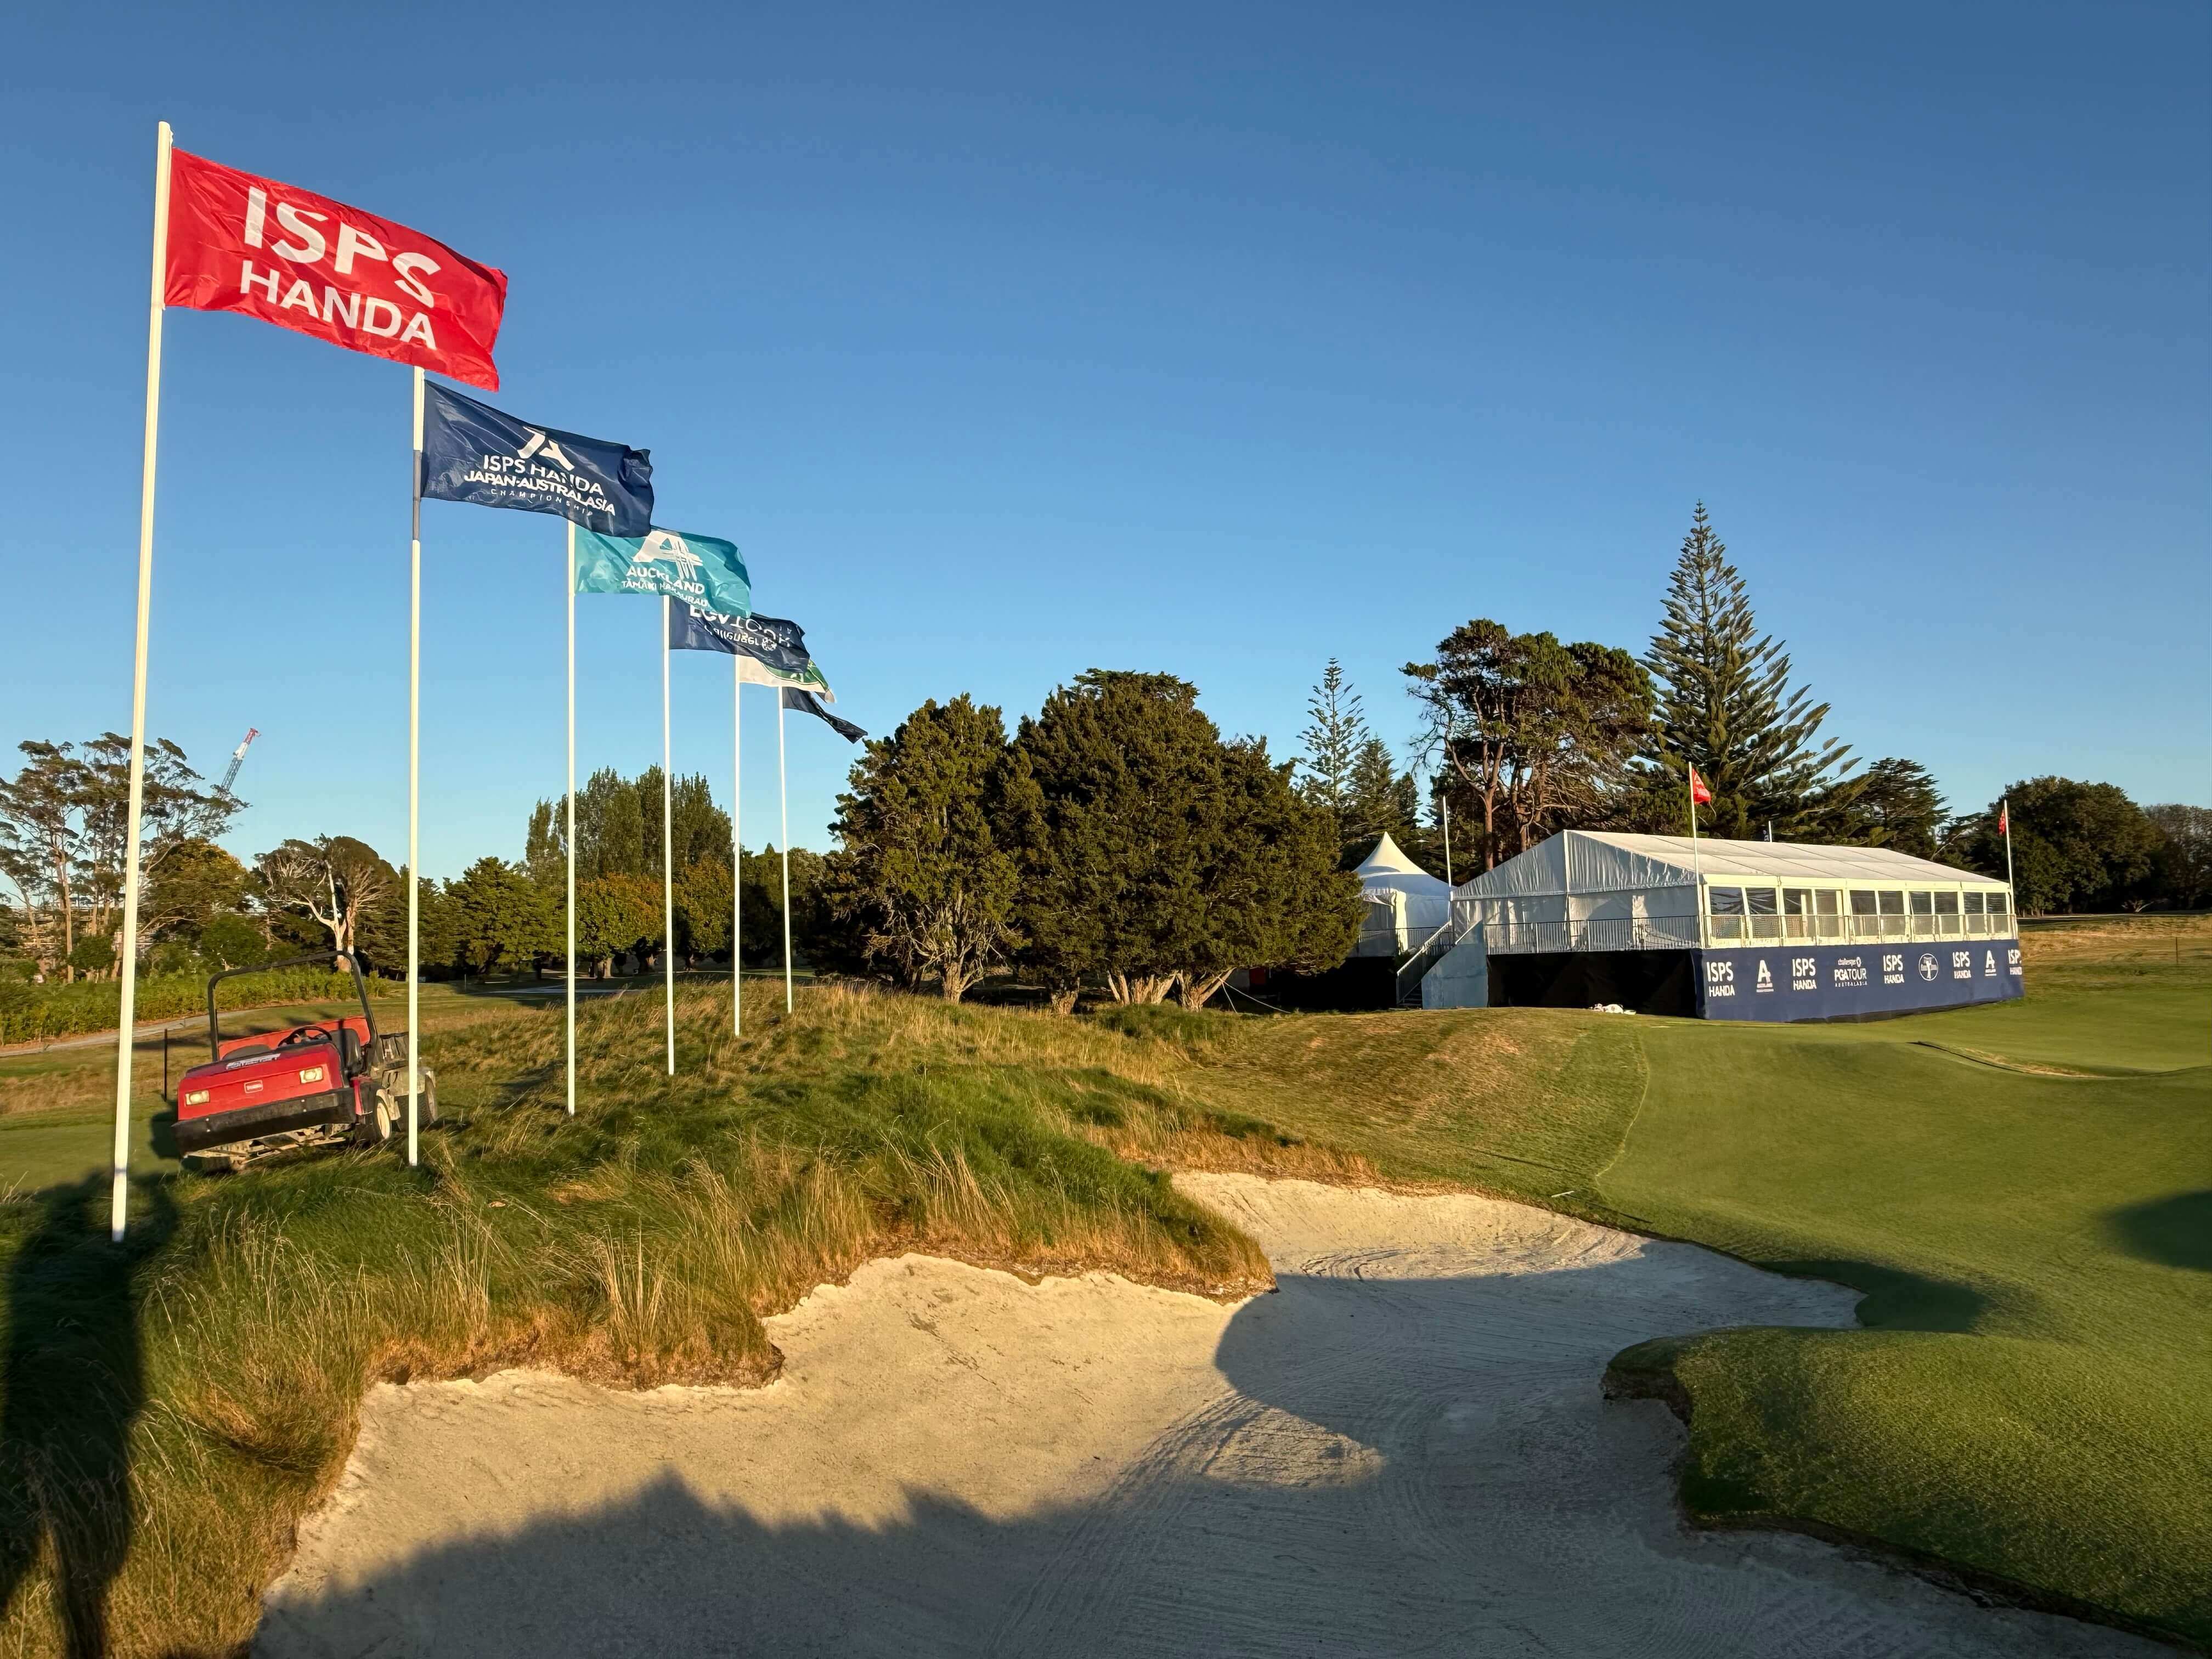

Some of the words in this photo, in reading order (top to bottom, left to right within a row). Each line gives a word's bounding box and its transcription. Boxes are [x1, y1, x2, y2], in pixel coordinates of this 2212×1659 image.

[244, 185, 441, 308] ISPS
[240, 260, 437, 350] HANDA
[483, 454, 526, 474] ISPS
[531, 464, 604, 496] HANDA
[464, 470, 616, 516] JAPAN-AUSTRALASIA
[491, 489, 593, 516] CHAMPIONSHIP
[626, 566, 705, 594] AUCKLAND
[1792, 958, 1816, 977] ISPS
[1883, 955, 1903, 971] ISPS
[1953, 951, 1970, 967] ISPS
[1707, 962, 1734, 982] ISPS
[1709, 985, 1735, 997] HANDA
[1793, 979, 1817, 991] HANDA
